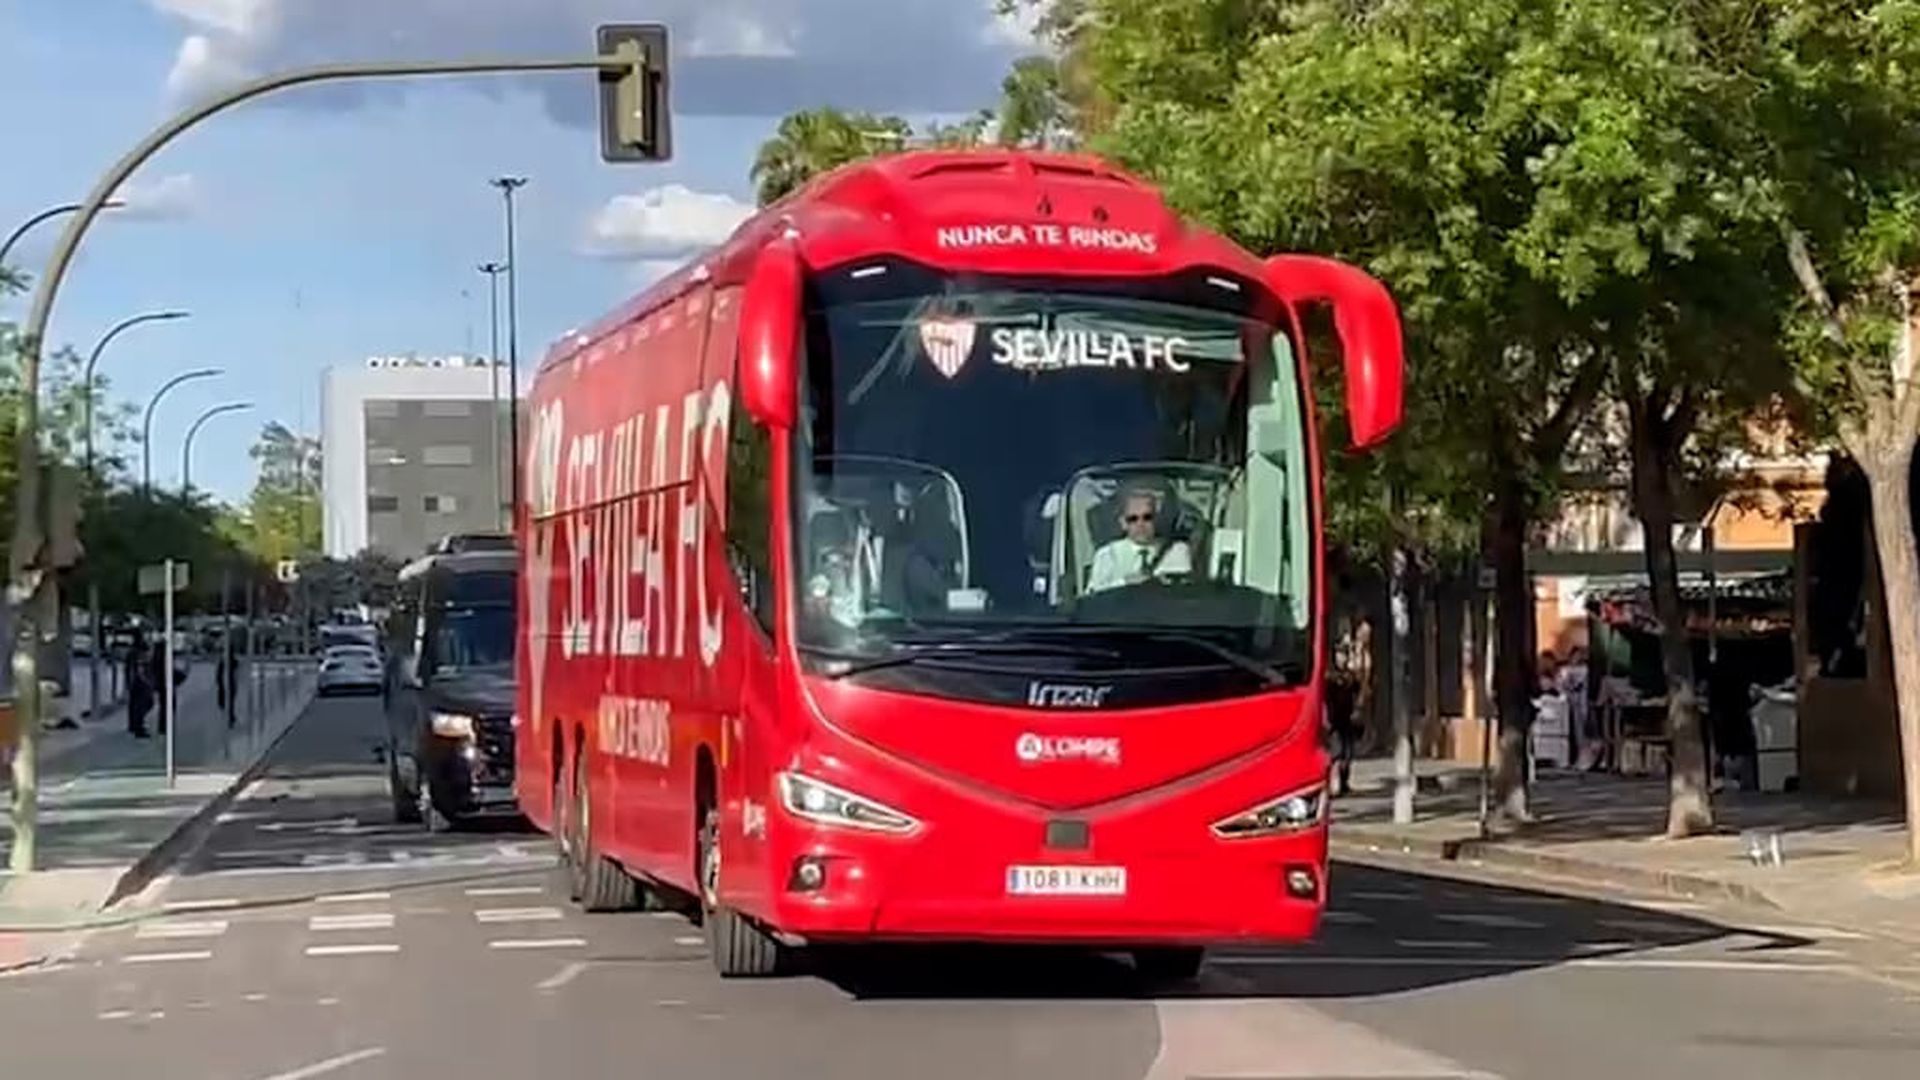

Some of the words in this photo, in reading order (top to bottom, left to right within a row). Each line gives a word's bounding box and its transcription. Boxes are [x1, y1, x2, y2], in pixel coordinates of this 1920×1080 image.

[937, 224, 1026, 248] NUNCA
[1032, 225, 1062, 245] TE
[1068, 226, 1157, 254] RINDAS
[991, 327, 1136, 368] SEVILLA
[1142, 336, 1191, 373] FC
[563, 404, 669, 661] SEVILLA
[674, 379, 731, 667] FC
[1024, 869, 1071, 889] 1081
